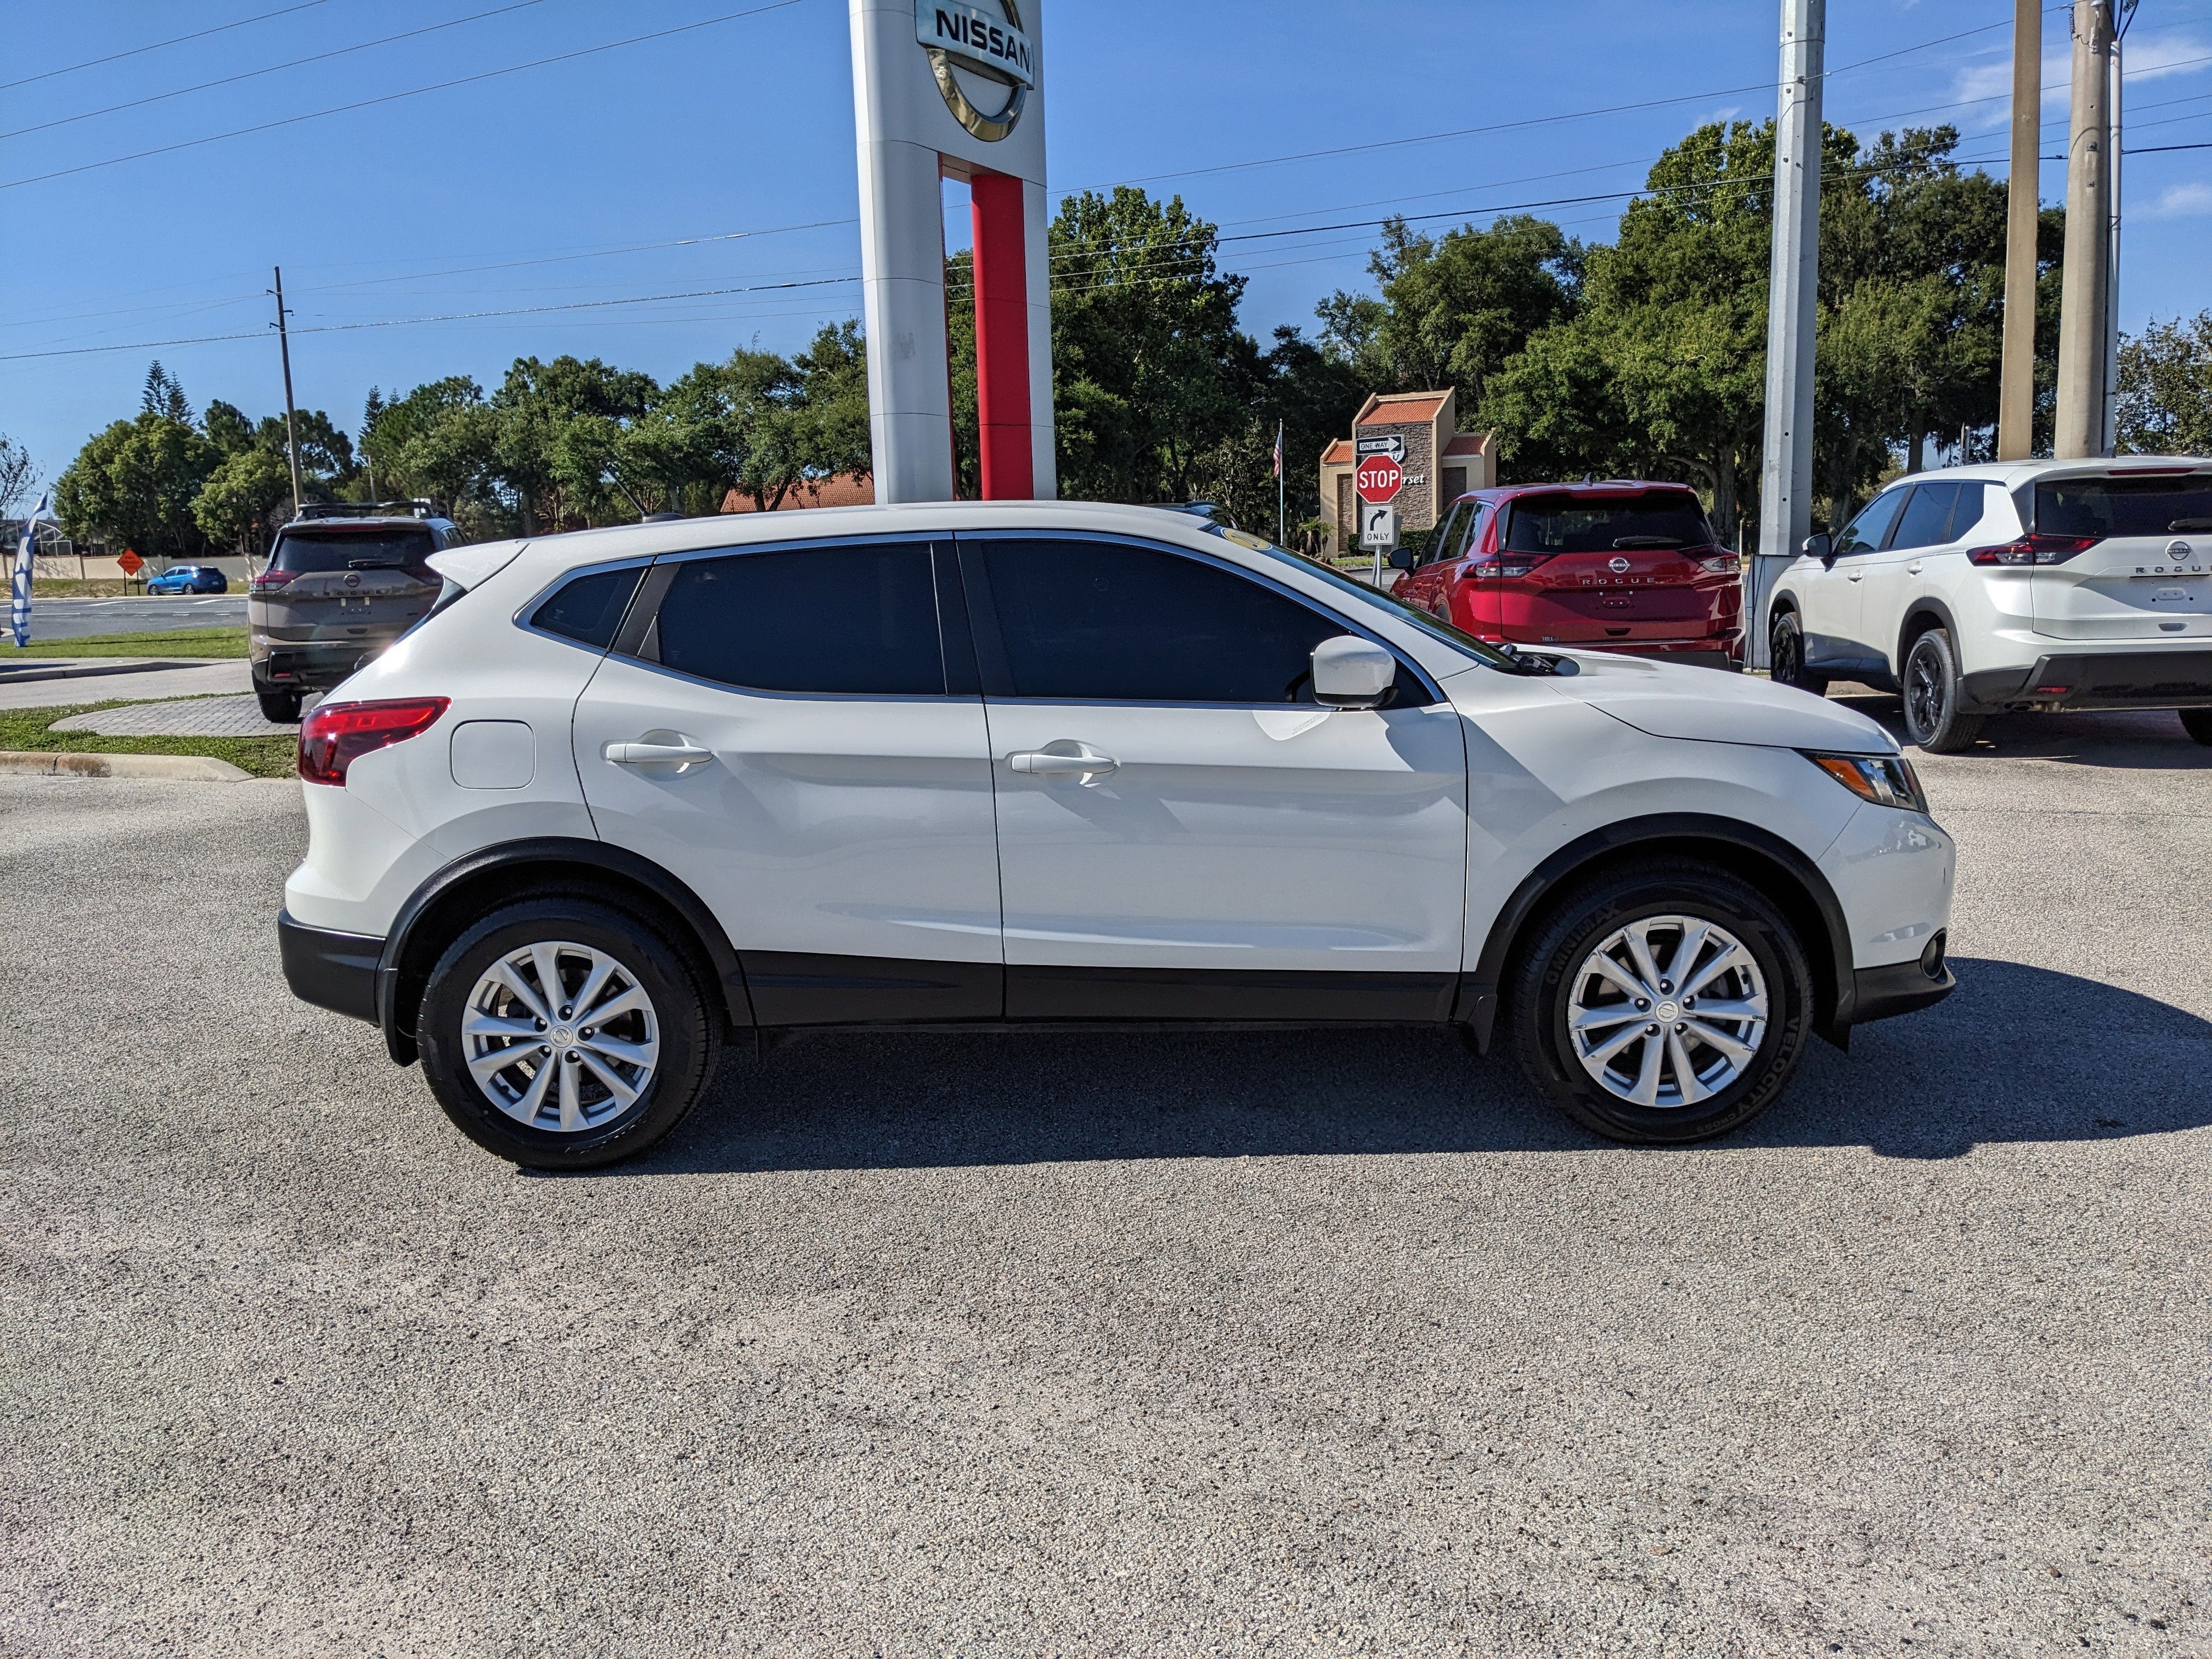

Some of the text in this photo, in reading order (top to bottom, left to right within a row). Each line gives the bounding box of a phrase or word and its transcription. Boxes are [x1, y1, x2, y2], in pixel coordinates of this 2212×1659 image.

[935, 8, 1031, 75] NISSAN
[1359, 470, 1399, 489] STOP
[1402, 473, 1425, 484] rset
[1367, 532, 1390, 541] ONLY
[1582, 577, 1655, 585] ROGUE
[1737, 1017, 1801, 1115] VELOCITY
